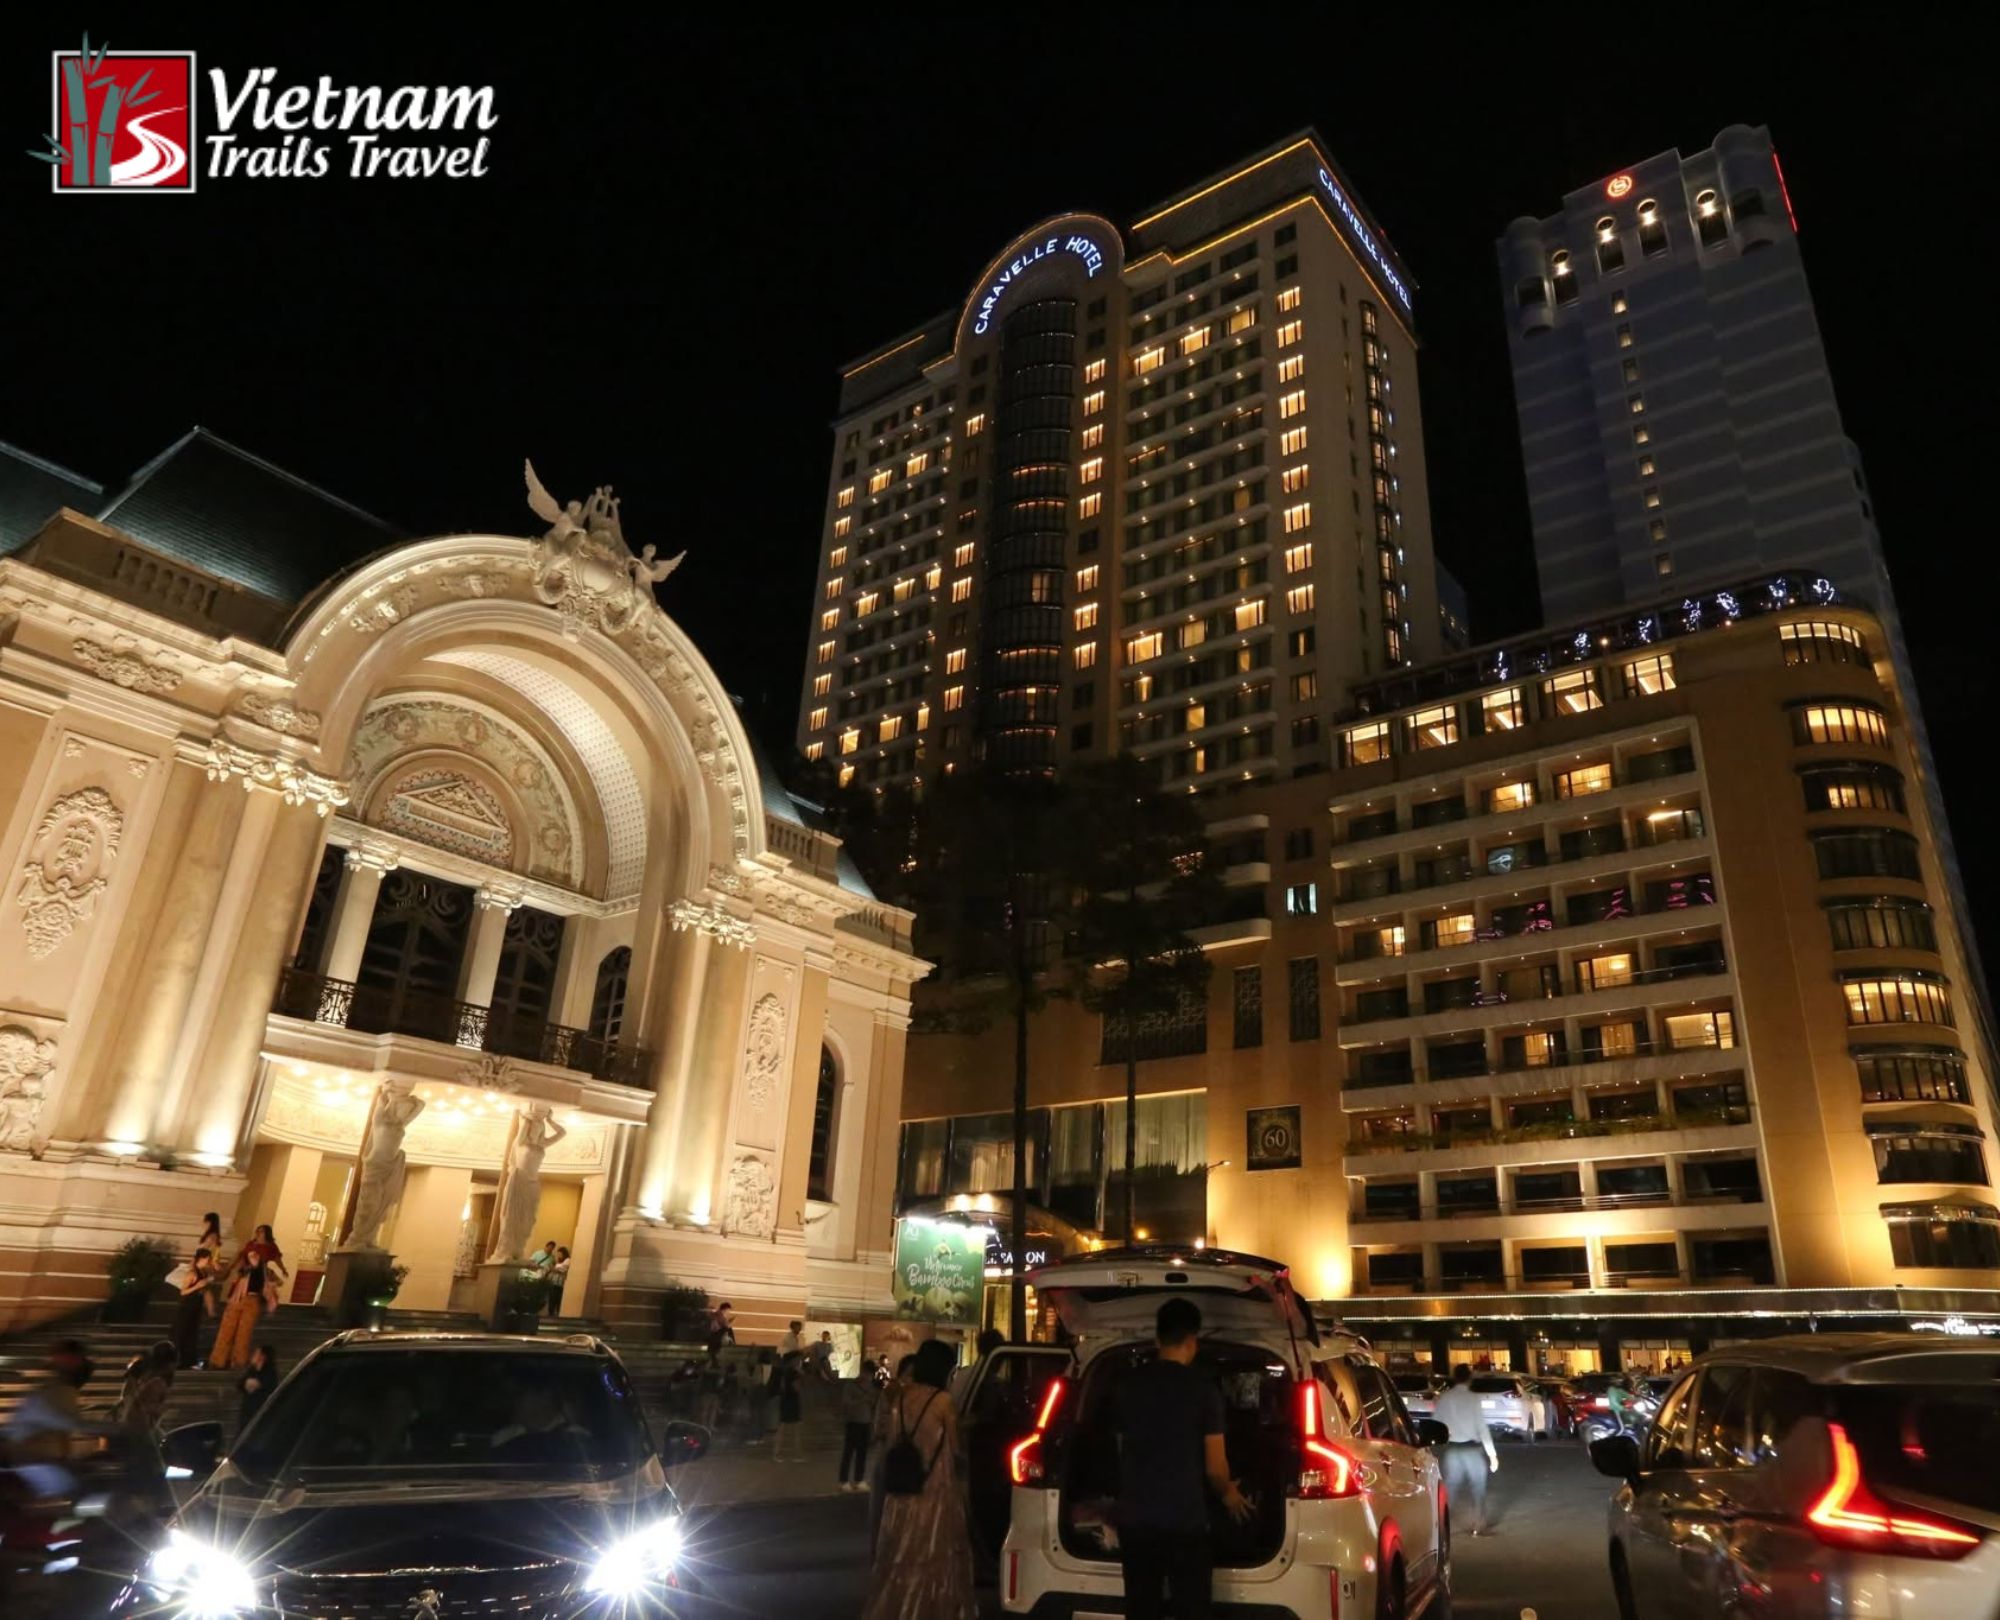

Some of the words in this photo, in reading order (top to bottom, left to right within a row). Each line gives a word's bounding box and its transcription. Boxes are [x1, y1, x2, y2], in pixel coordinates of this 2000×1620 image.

[974, 238, 1058, 335] CARAVELLE
[1065, 235, 1103, 278] HOTEL
[1318, 167, 1378, 262] CARAVELLE
[1380, 257, 1412, 311] HOTEL
[1265, 1128, 1286, 1148] 60
